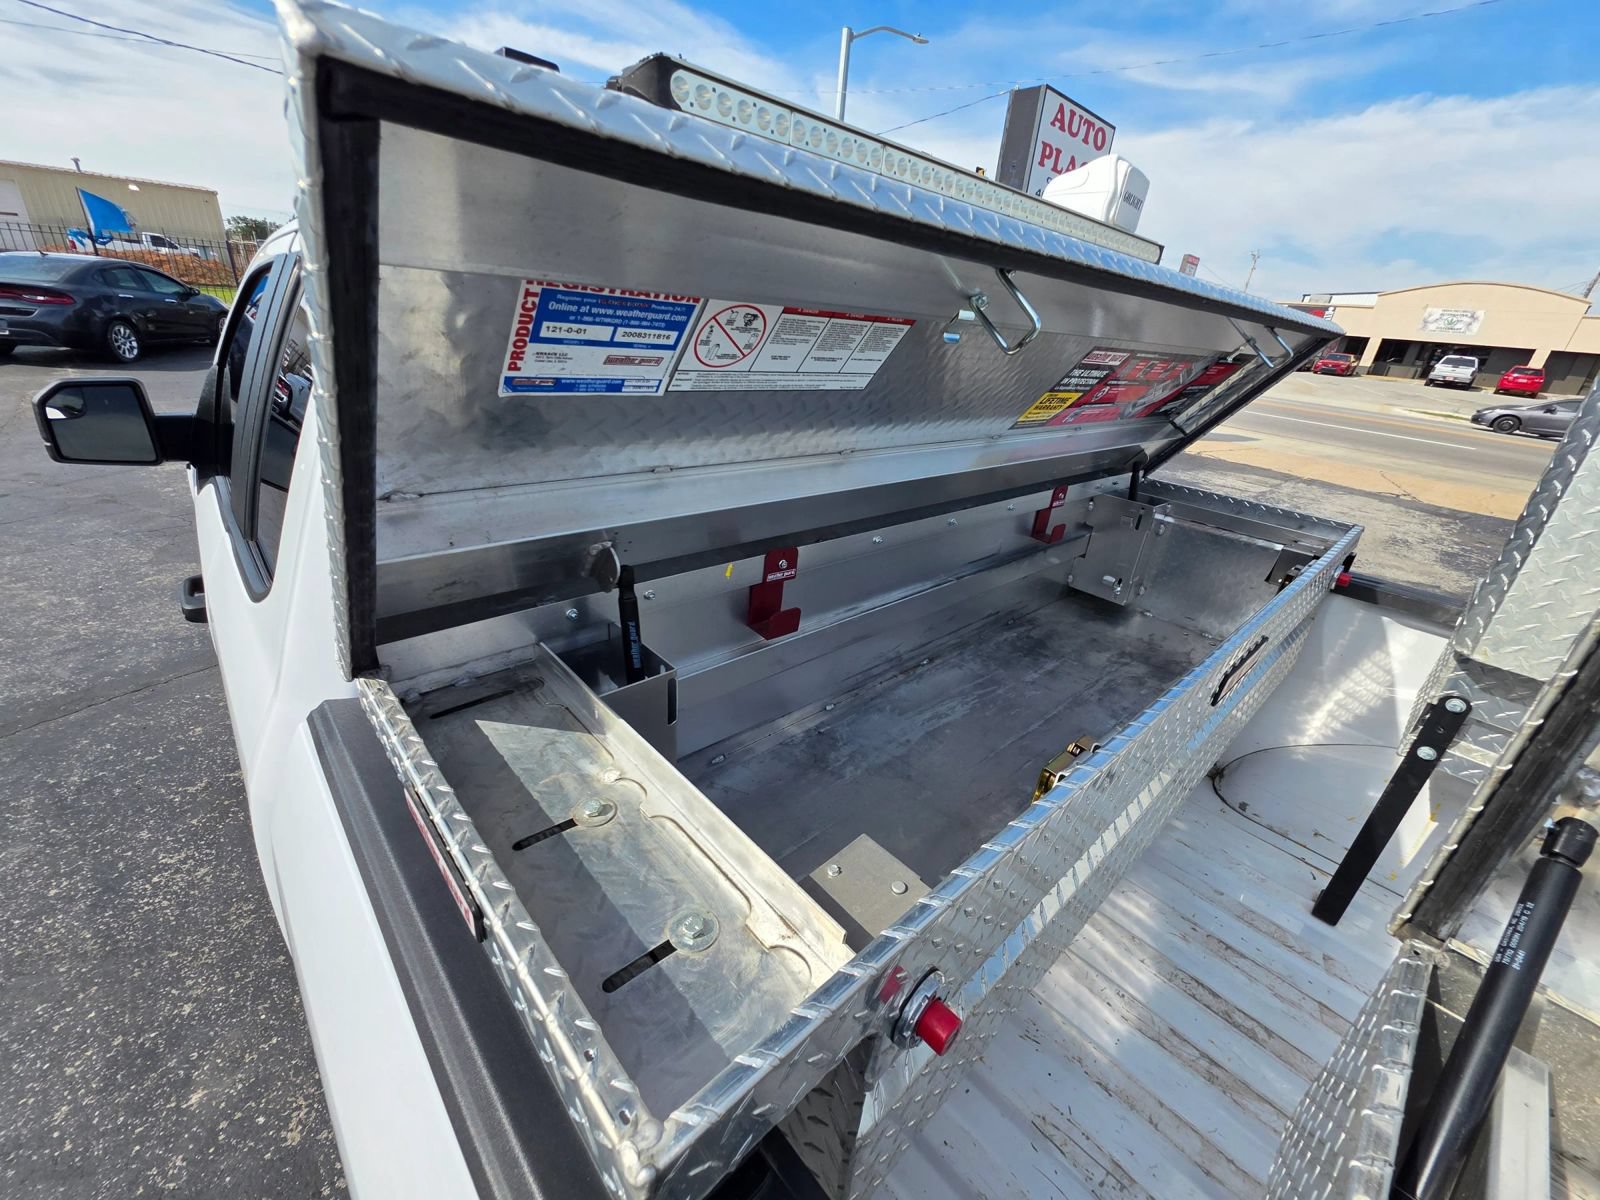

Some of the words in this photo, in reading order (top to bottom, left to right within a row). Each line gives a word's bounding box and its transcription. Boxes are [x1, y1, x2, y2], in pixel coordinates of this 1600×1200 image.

[1050, 103, 1107, 151] AUTO
[1038, 141, 1090, 175] PLA
[548, 301, 578, 313] Online
[579, 304, 590, 313] at
[591, 306, 688, 322] www.weatherguard.com
[507, 288, 540, 372] PRODUCT
[545, 325, 587, 335] 121-0-01
[621, 331, 671, 340] 2008311816
